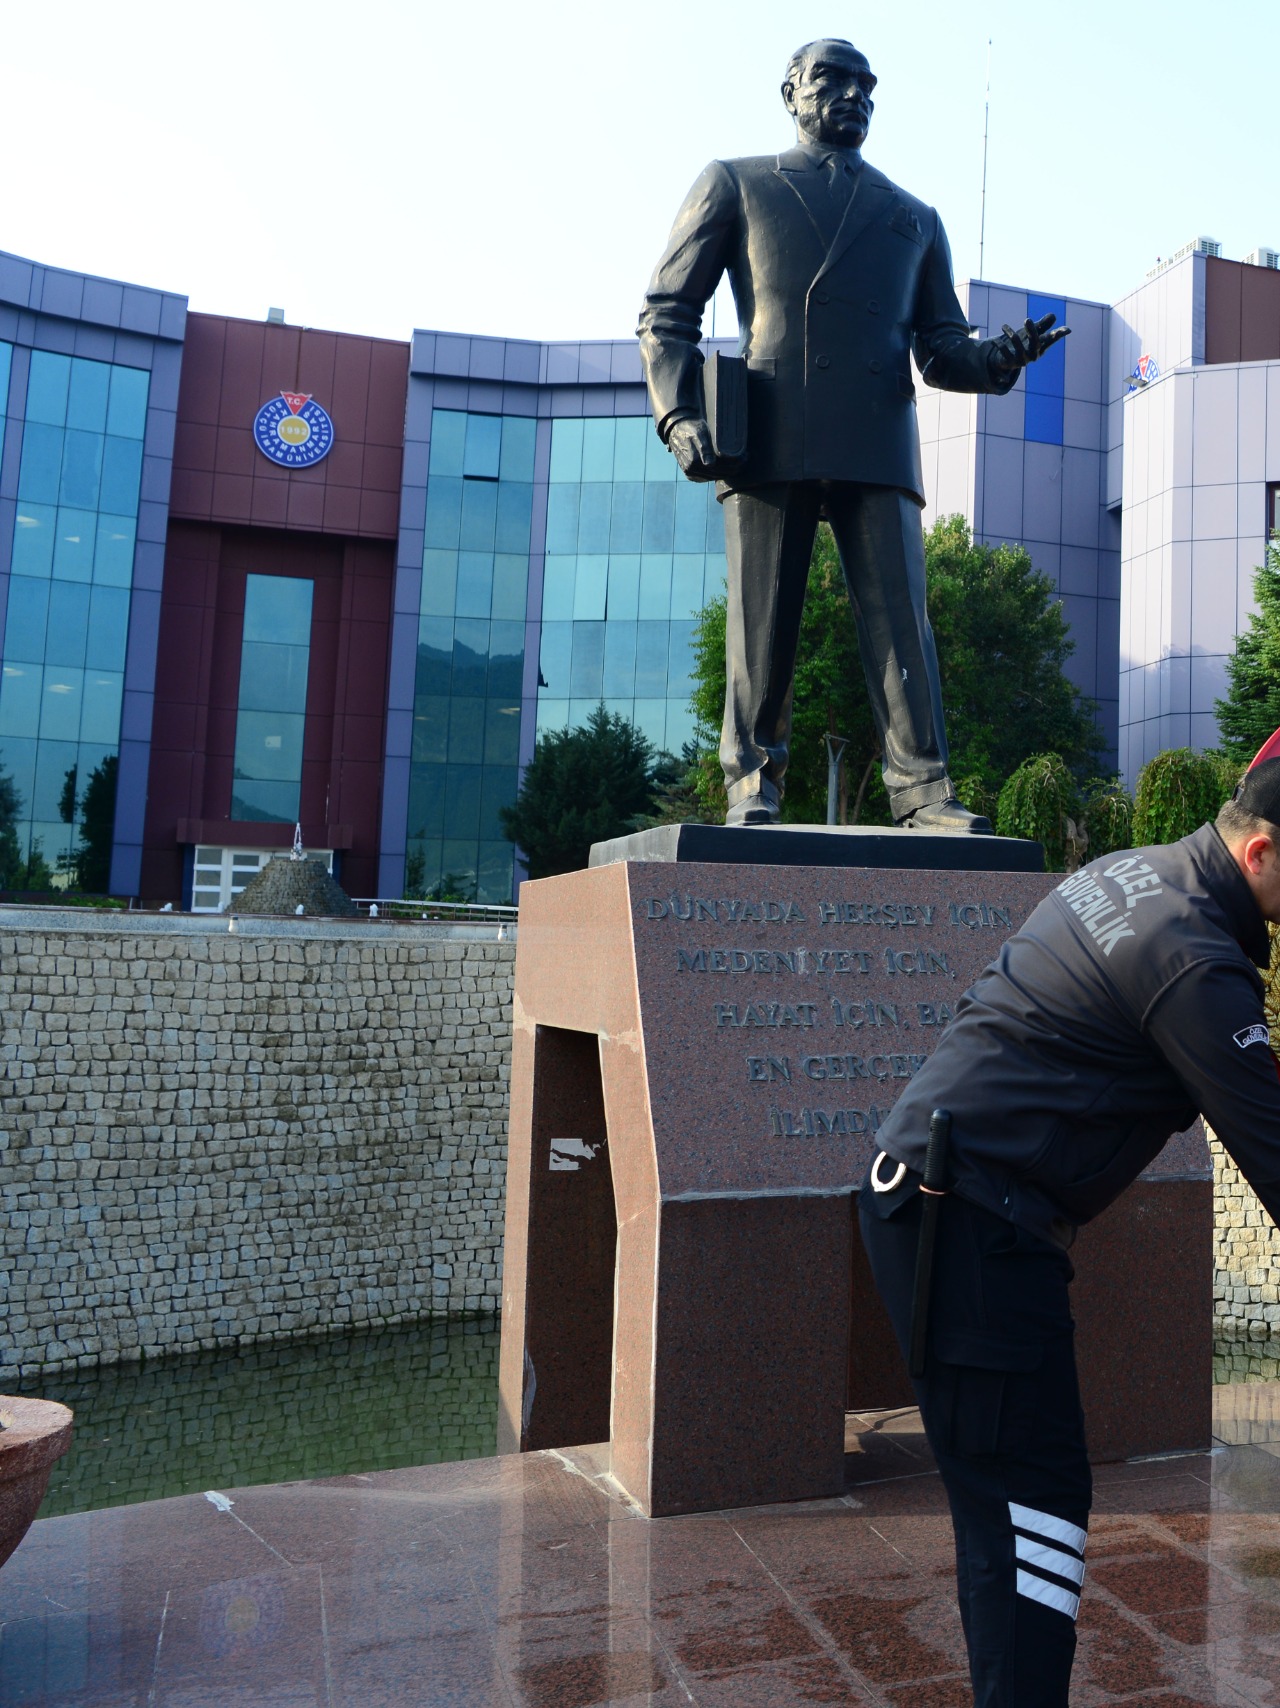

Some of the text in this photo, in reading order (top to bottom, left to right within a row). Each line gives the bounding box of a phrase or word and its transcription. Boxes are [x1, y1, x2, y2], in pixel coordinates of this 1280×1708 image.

[287, 397, 303, 406] T.C.
[280, 426, 308, 436] 1992
[1103, 855, 1163, 909] ÖZEL
[645, 893, 807, 923] DÜNYADA
[818, 901, 937, 929] HERŞEY
[1056, 869, 1136, 957] GÜVENLİK
[676, 946, 872, 975] MEDENİYET
[713, 1002, 816, 1028] HAYAT
[746, 1055, 791, 1083] EN
